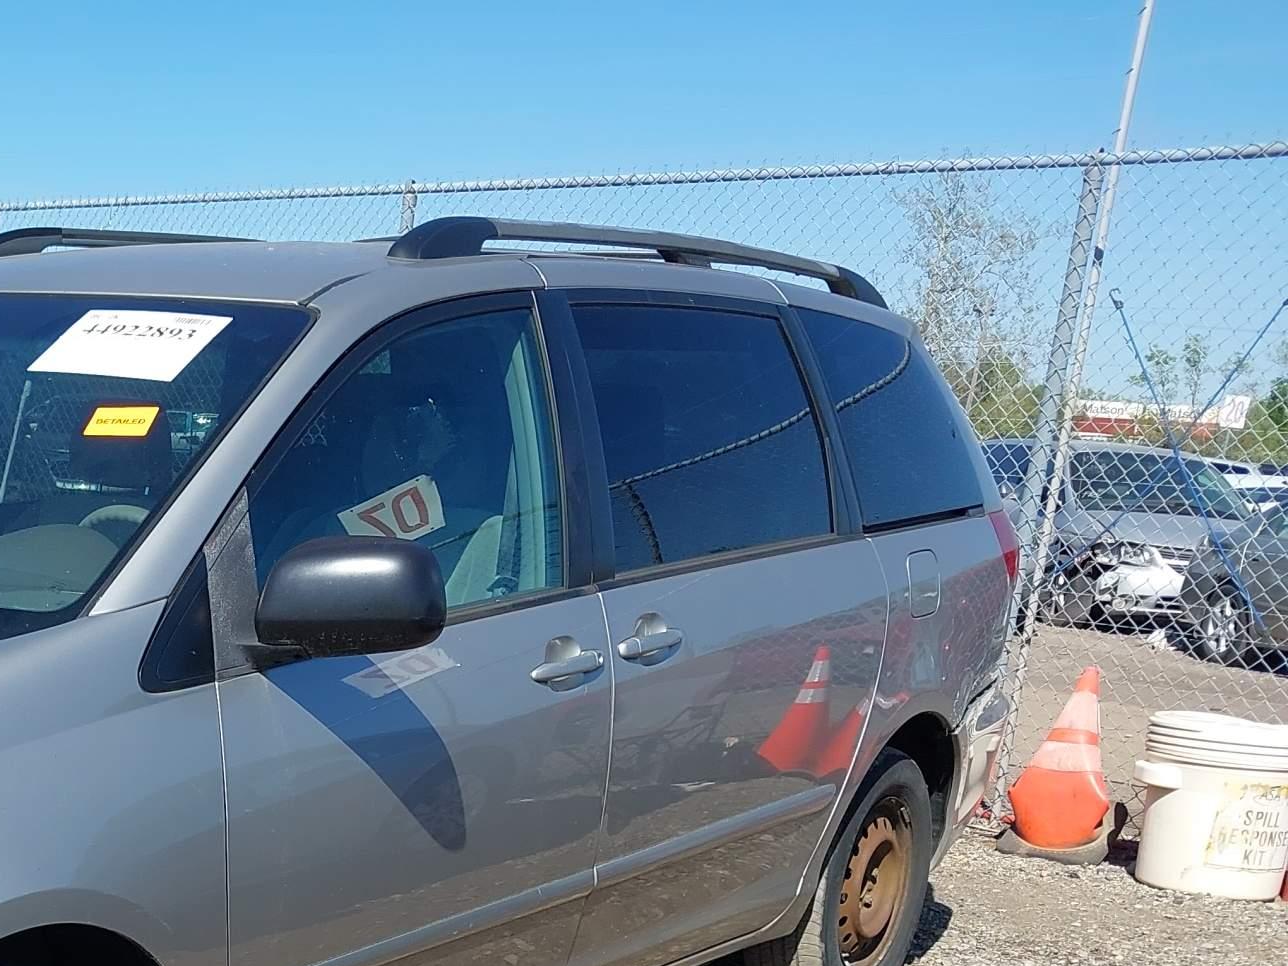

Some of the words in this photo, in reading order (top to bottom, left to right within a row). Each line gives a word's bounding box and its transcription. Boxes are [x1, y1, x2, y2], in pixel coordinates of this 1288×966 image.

[82, 322, 198, 341] 44922893
[95, 417, 146, 425] DETAILED
[1243, 809, 1280, 828] SPILL
[1243, 848, 1267, 866] KIT
